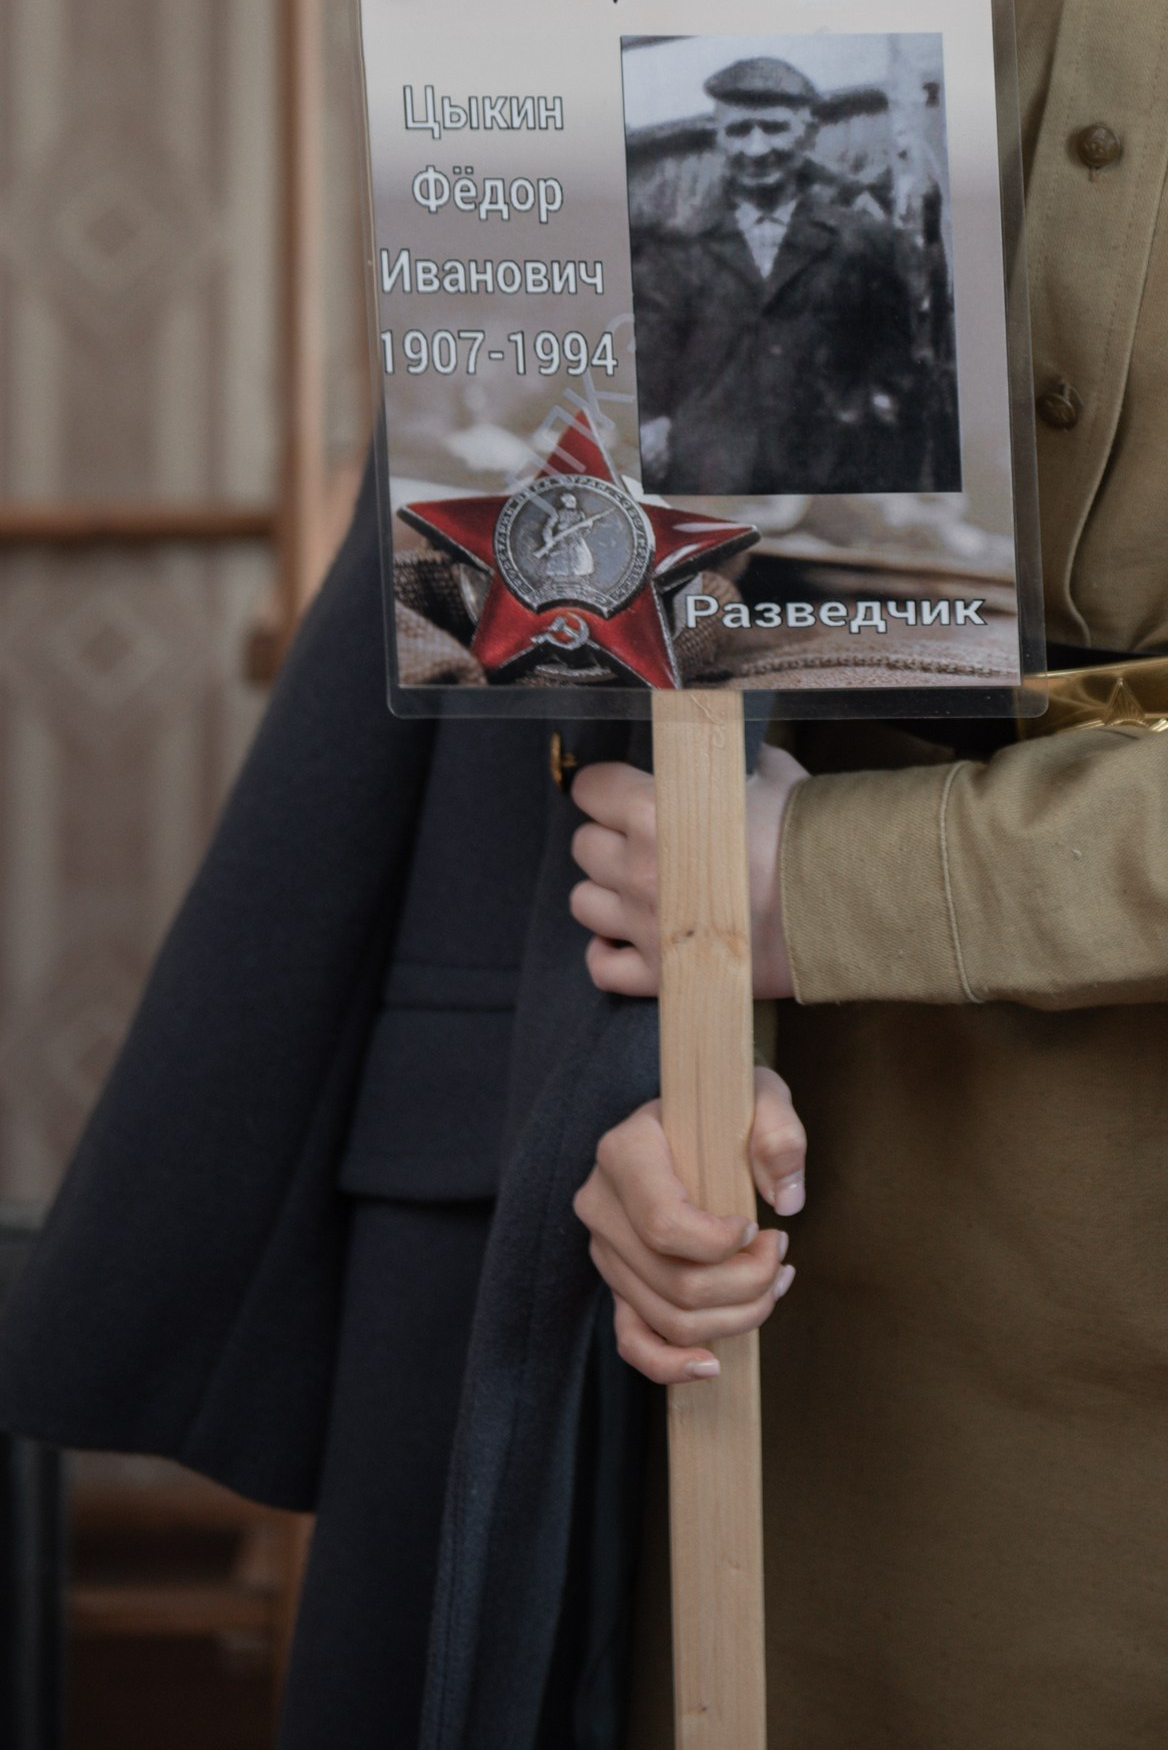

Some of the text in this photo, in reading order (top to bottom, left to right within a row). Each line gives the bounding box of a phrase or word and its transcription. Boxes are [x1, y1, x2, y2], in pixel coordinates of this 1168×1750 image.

[402, 84, 564, 140] Цыкин
[412, 164, 564, 224] Фёдор
[379, 248, 605, 295] Иванович
[380, 328, 619, 377] 1907-1994
[684, 593, 988, 635] Разведчик
